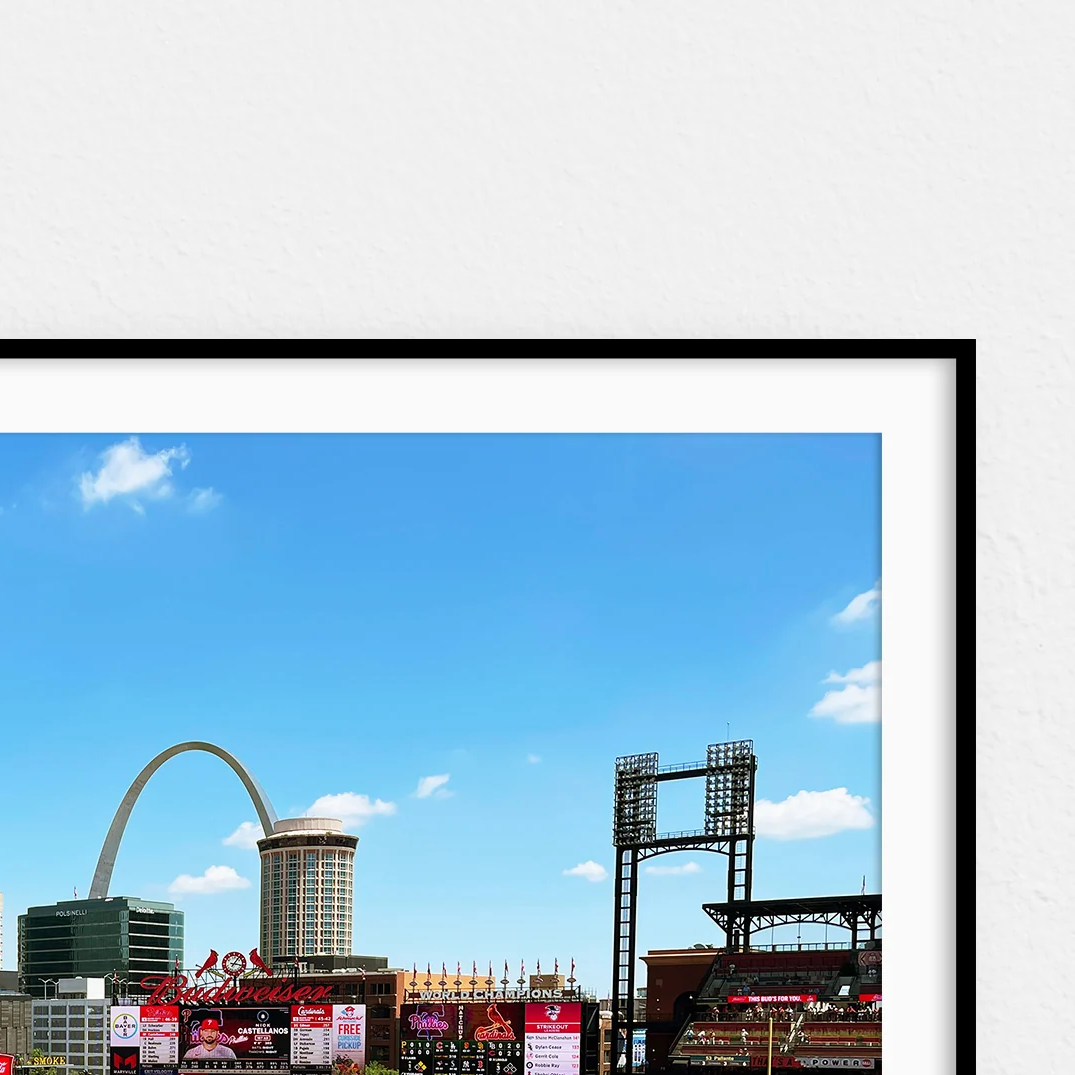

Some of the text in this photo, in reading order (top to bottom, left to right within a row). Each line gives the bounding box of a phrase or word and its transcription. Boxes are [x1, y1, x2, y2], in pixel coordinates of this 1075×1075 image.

[55, 908, 88, 917] POLSINELLI
[140, 974, 333, 1006] Budweiser
[419, 989, 564, 1000] WORLD CHAMPIONS
[298, 1006, 325, 1016] Cardinals
[408, 1014, 450, 1030] Phillies
[338, 1024, 361, 1035] FREE
[474, 1028, 516, 1041] Cardinals
[338, 1042, 362, 1050] PICKUP
[33, 1056, 66, 1065] SMOKE
[812, 1059, 859, 1067] POWER
